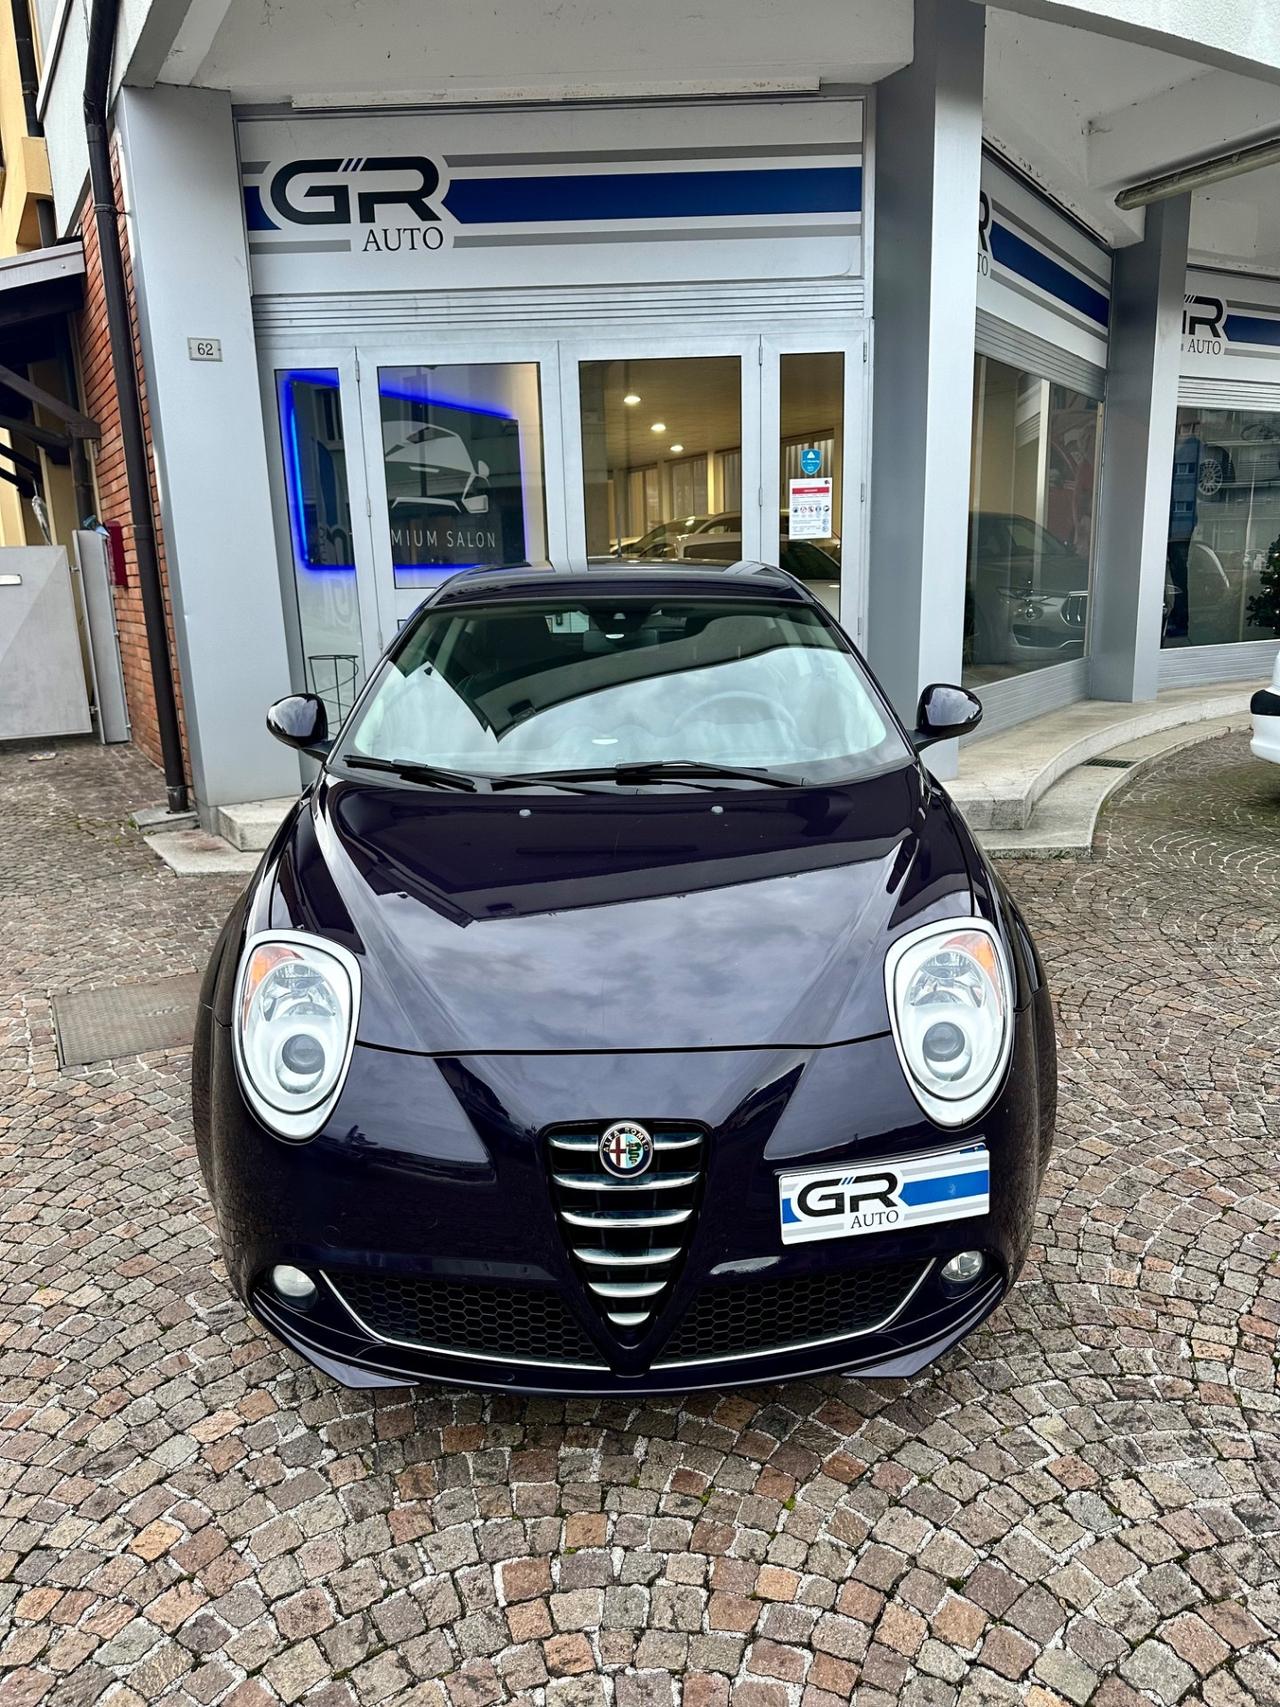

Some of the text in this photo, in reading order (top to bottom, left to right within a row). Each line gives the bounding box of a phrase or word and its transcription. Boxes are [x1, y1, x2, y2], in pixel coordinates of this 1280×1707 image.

[270, 156, 442, 225] GR
[362, 226, 444, 252] AUTO
[197, 342, 214, 356] 62
[1187, 339, 1222, 356] AUTO
[446, 530, 496, 548] SALON
[603, 1130, 620, 1153] ALFA
[797, 1172, 898, 1218] GR
[850, 1209, 900, 1230] AUTO
